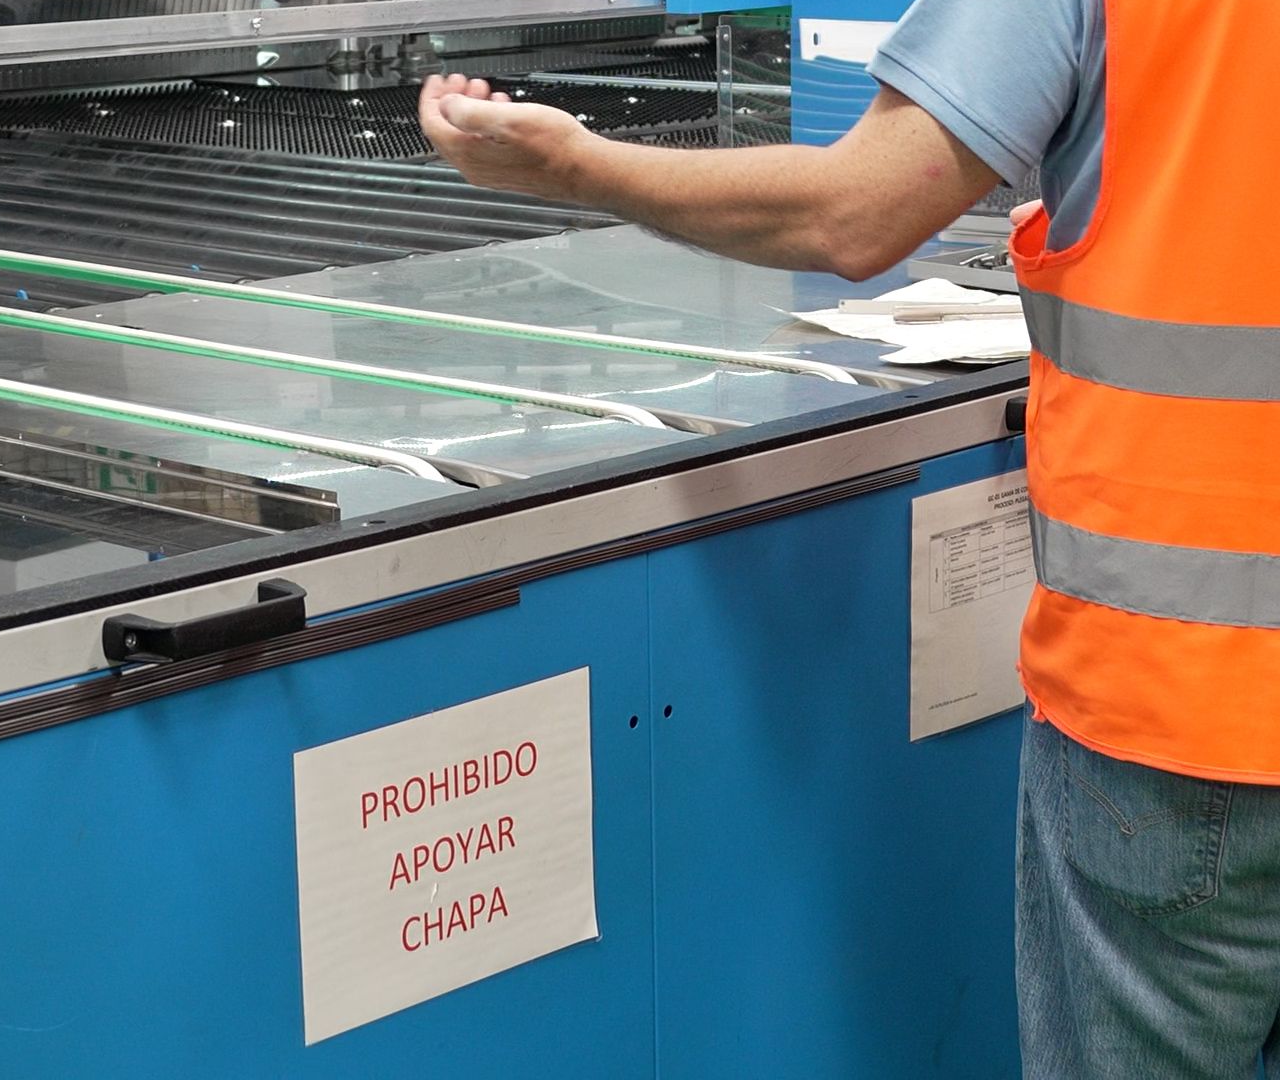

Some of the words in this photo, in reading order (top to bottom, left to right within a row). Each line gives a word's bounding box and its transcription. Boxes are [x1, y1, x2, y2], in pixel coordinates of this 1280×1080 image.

[360, 741, 538, 829] PROHIBIDO
[388, 816, 516, 890] APOYAR
[401, 886, 509, 952] CHAPA
